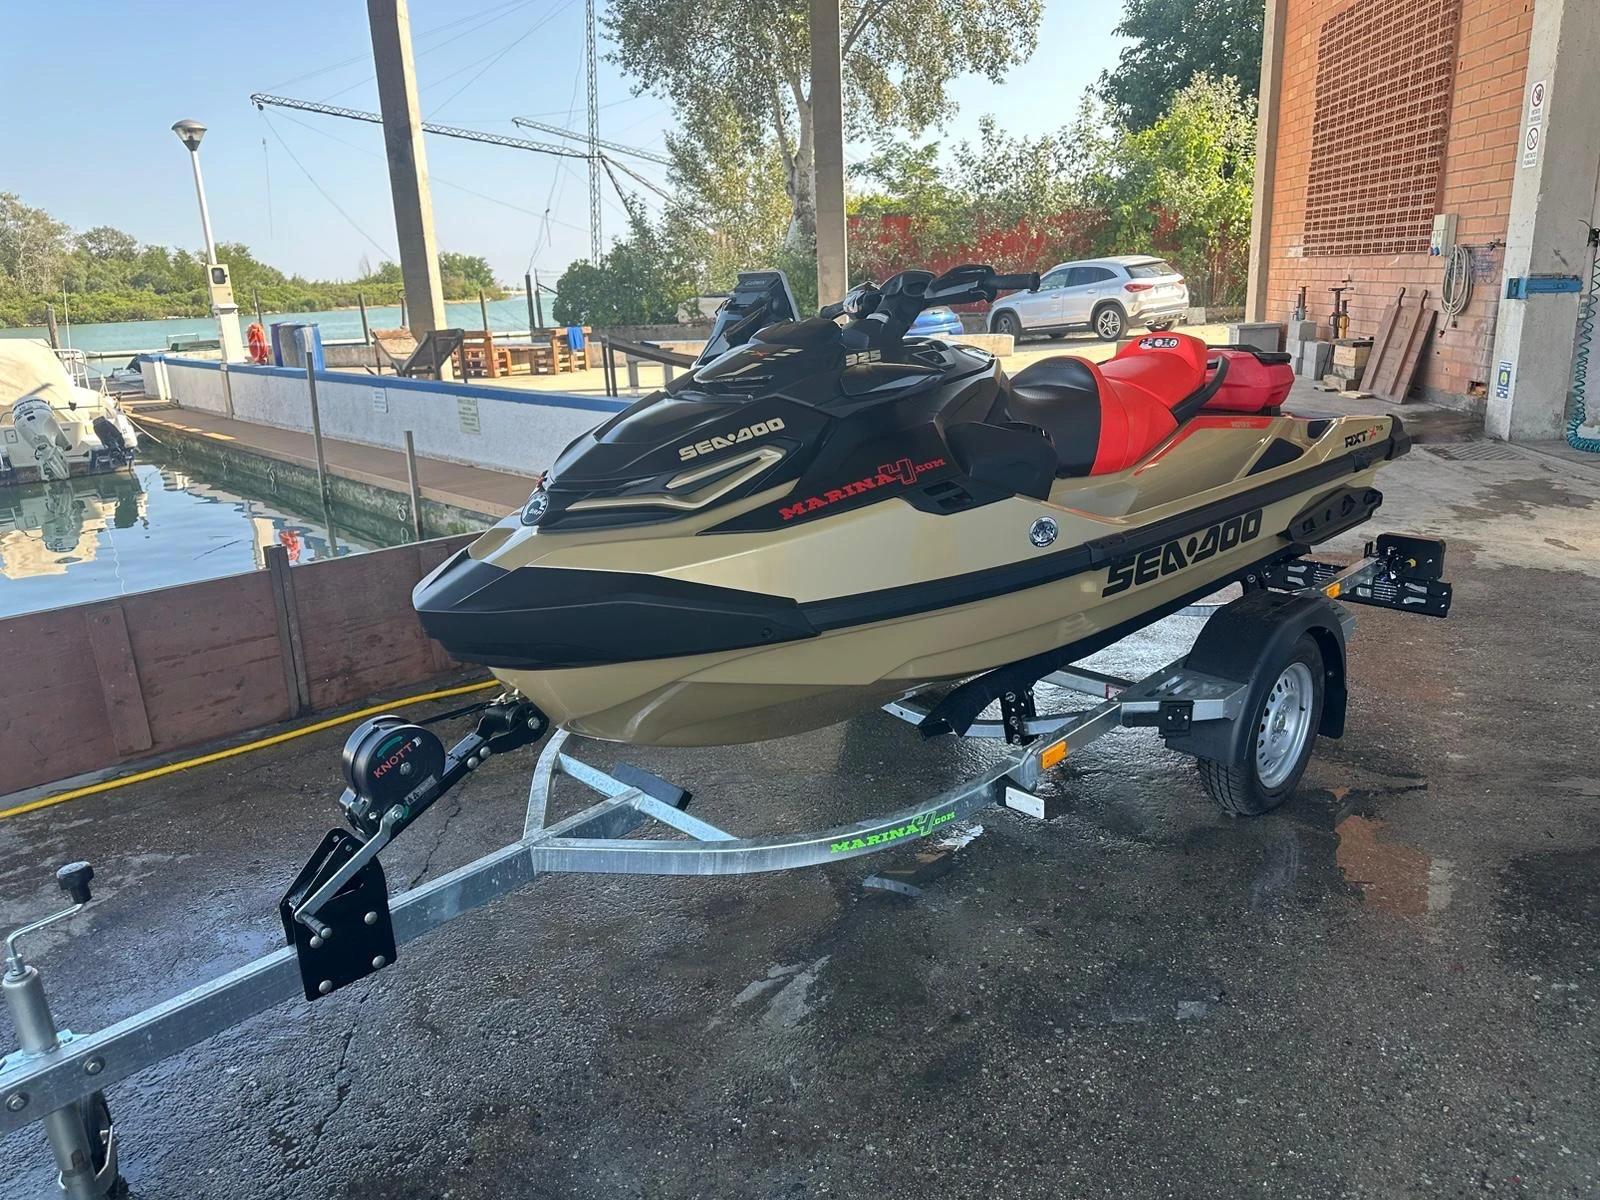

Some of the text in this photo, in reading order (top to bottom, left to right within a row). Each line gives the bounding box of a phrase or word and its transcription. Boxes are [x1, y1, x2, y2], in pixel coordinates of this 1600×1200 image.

[845, 349, 882, 366] 325
[1344, 430, 1368, 448] RXT
[373, 742, 412, 779] KNOTT
